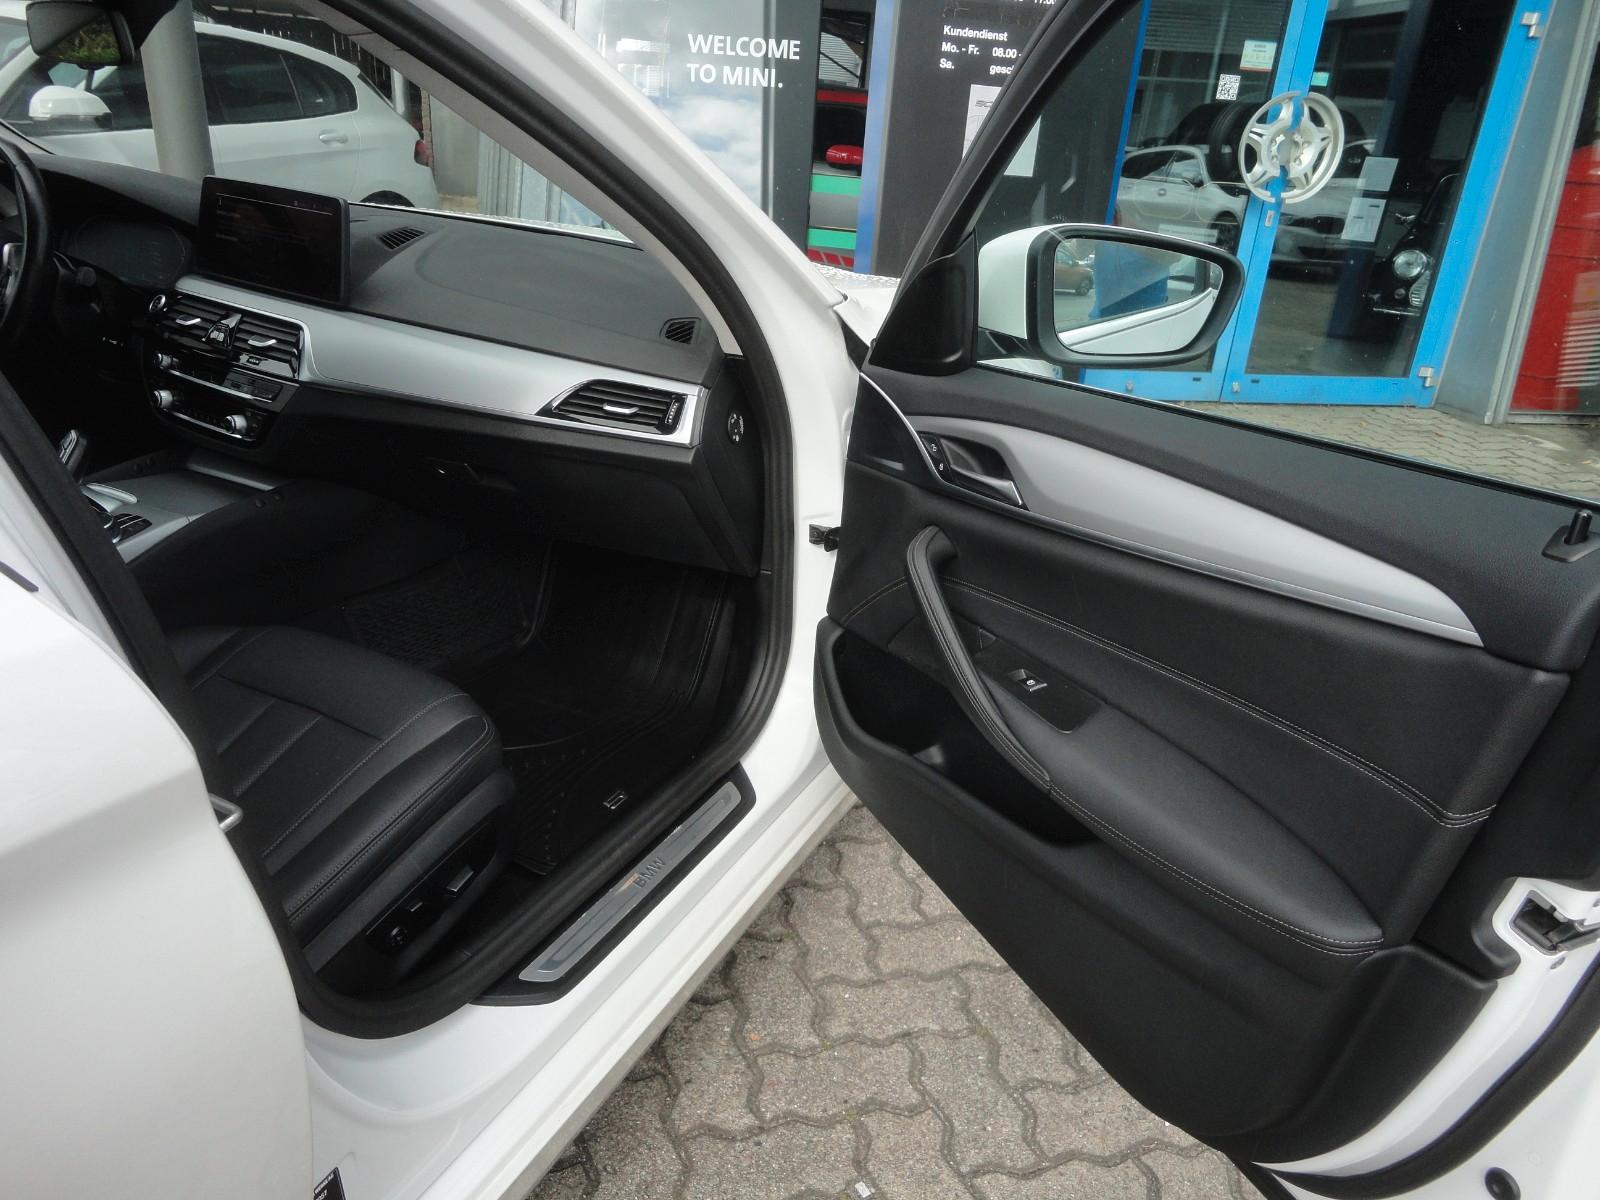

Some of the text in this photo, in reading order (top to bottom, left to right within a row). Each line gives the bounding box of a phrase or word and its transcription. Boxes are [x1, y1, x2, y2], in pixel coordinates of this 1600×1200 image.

[943, 25, 1008, 41] Kundendienst
[687, 33, 801, 60] WELCOME
[941, 41, 959, 53] Mo.
[967, 44, 980, 55] Fr.
[992, 47, 1017, 59] 08.00
[686, 63, 784, 89] TO MINI.
[939, 58, 1015, 75] Sa. gesc
[633, 856, 665, 888] BMW
